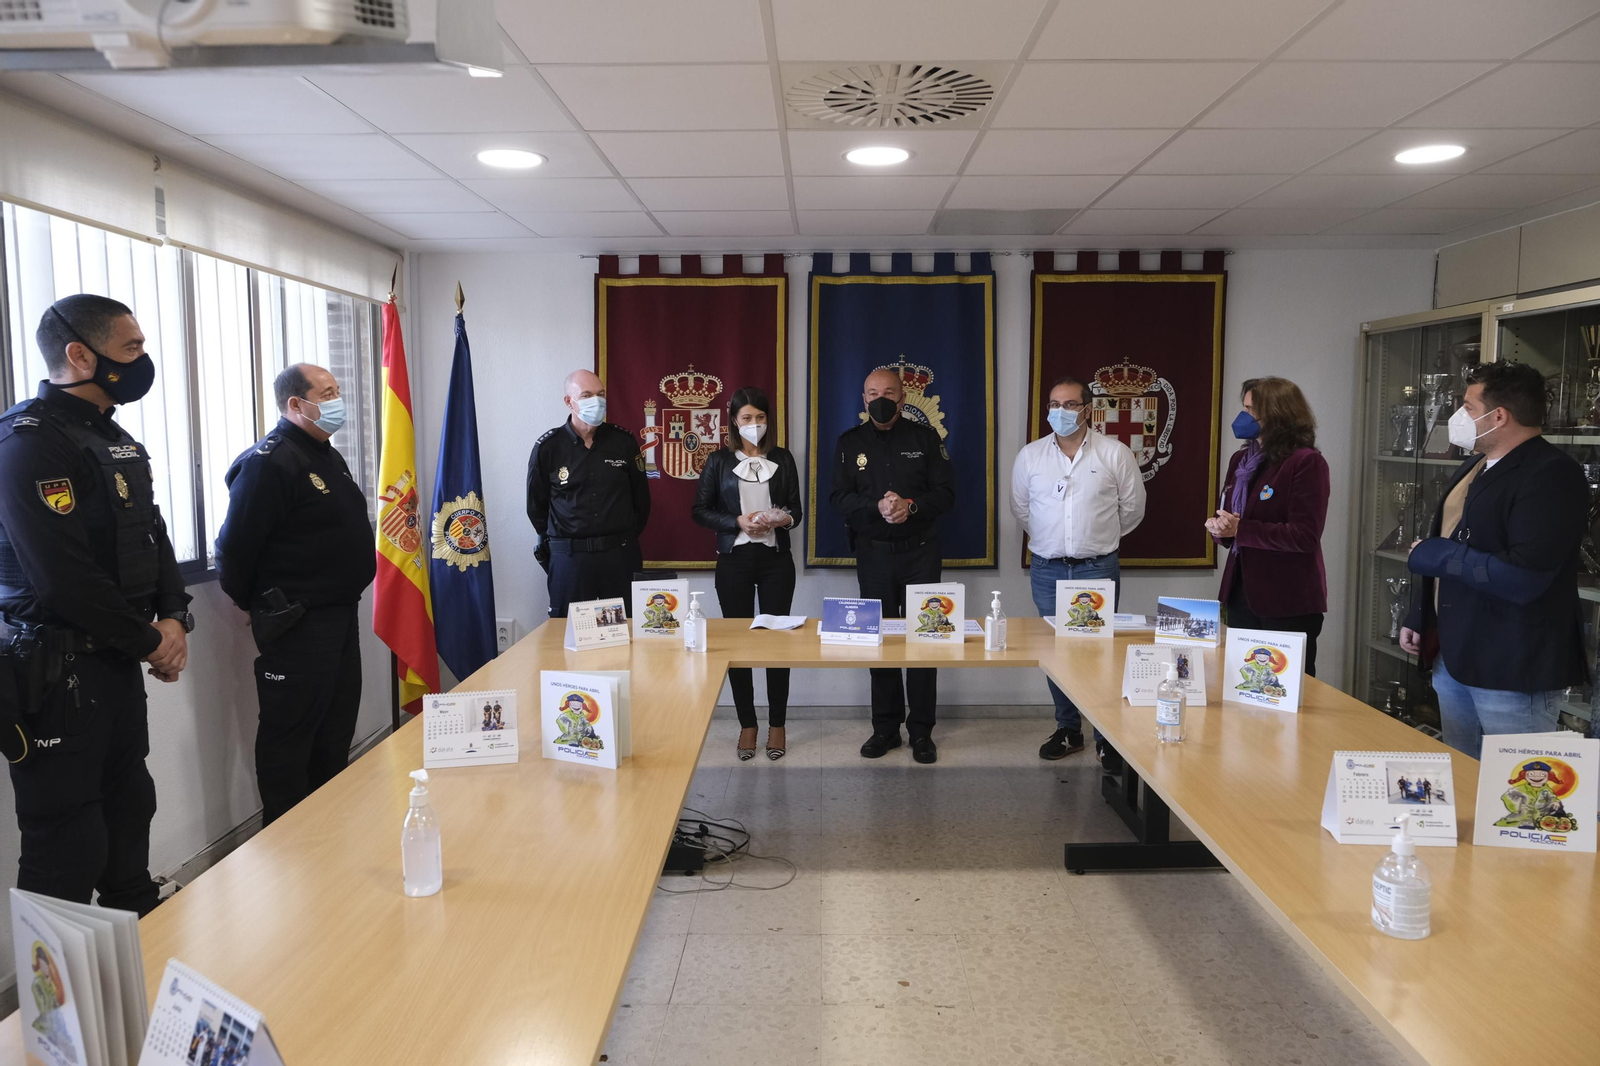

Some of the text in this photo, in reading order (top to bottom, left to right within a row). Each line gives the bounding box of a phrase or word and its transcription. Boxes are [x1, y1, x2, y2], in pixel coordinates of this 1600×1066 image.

[1057, 484, 1064, 494] V
[450, 509, 476, 520] CUERPO
[264, 672, 286, 682] CNP
[1518, 748, 1544, 756] HÉROES
